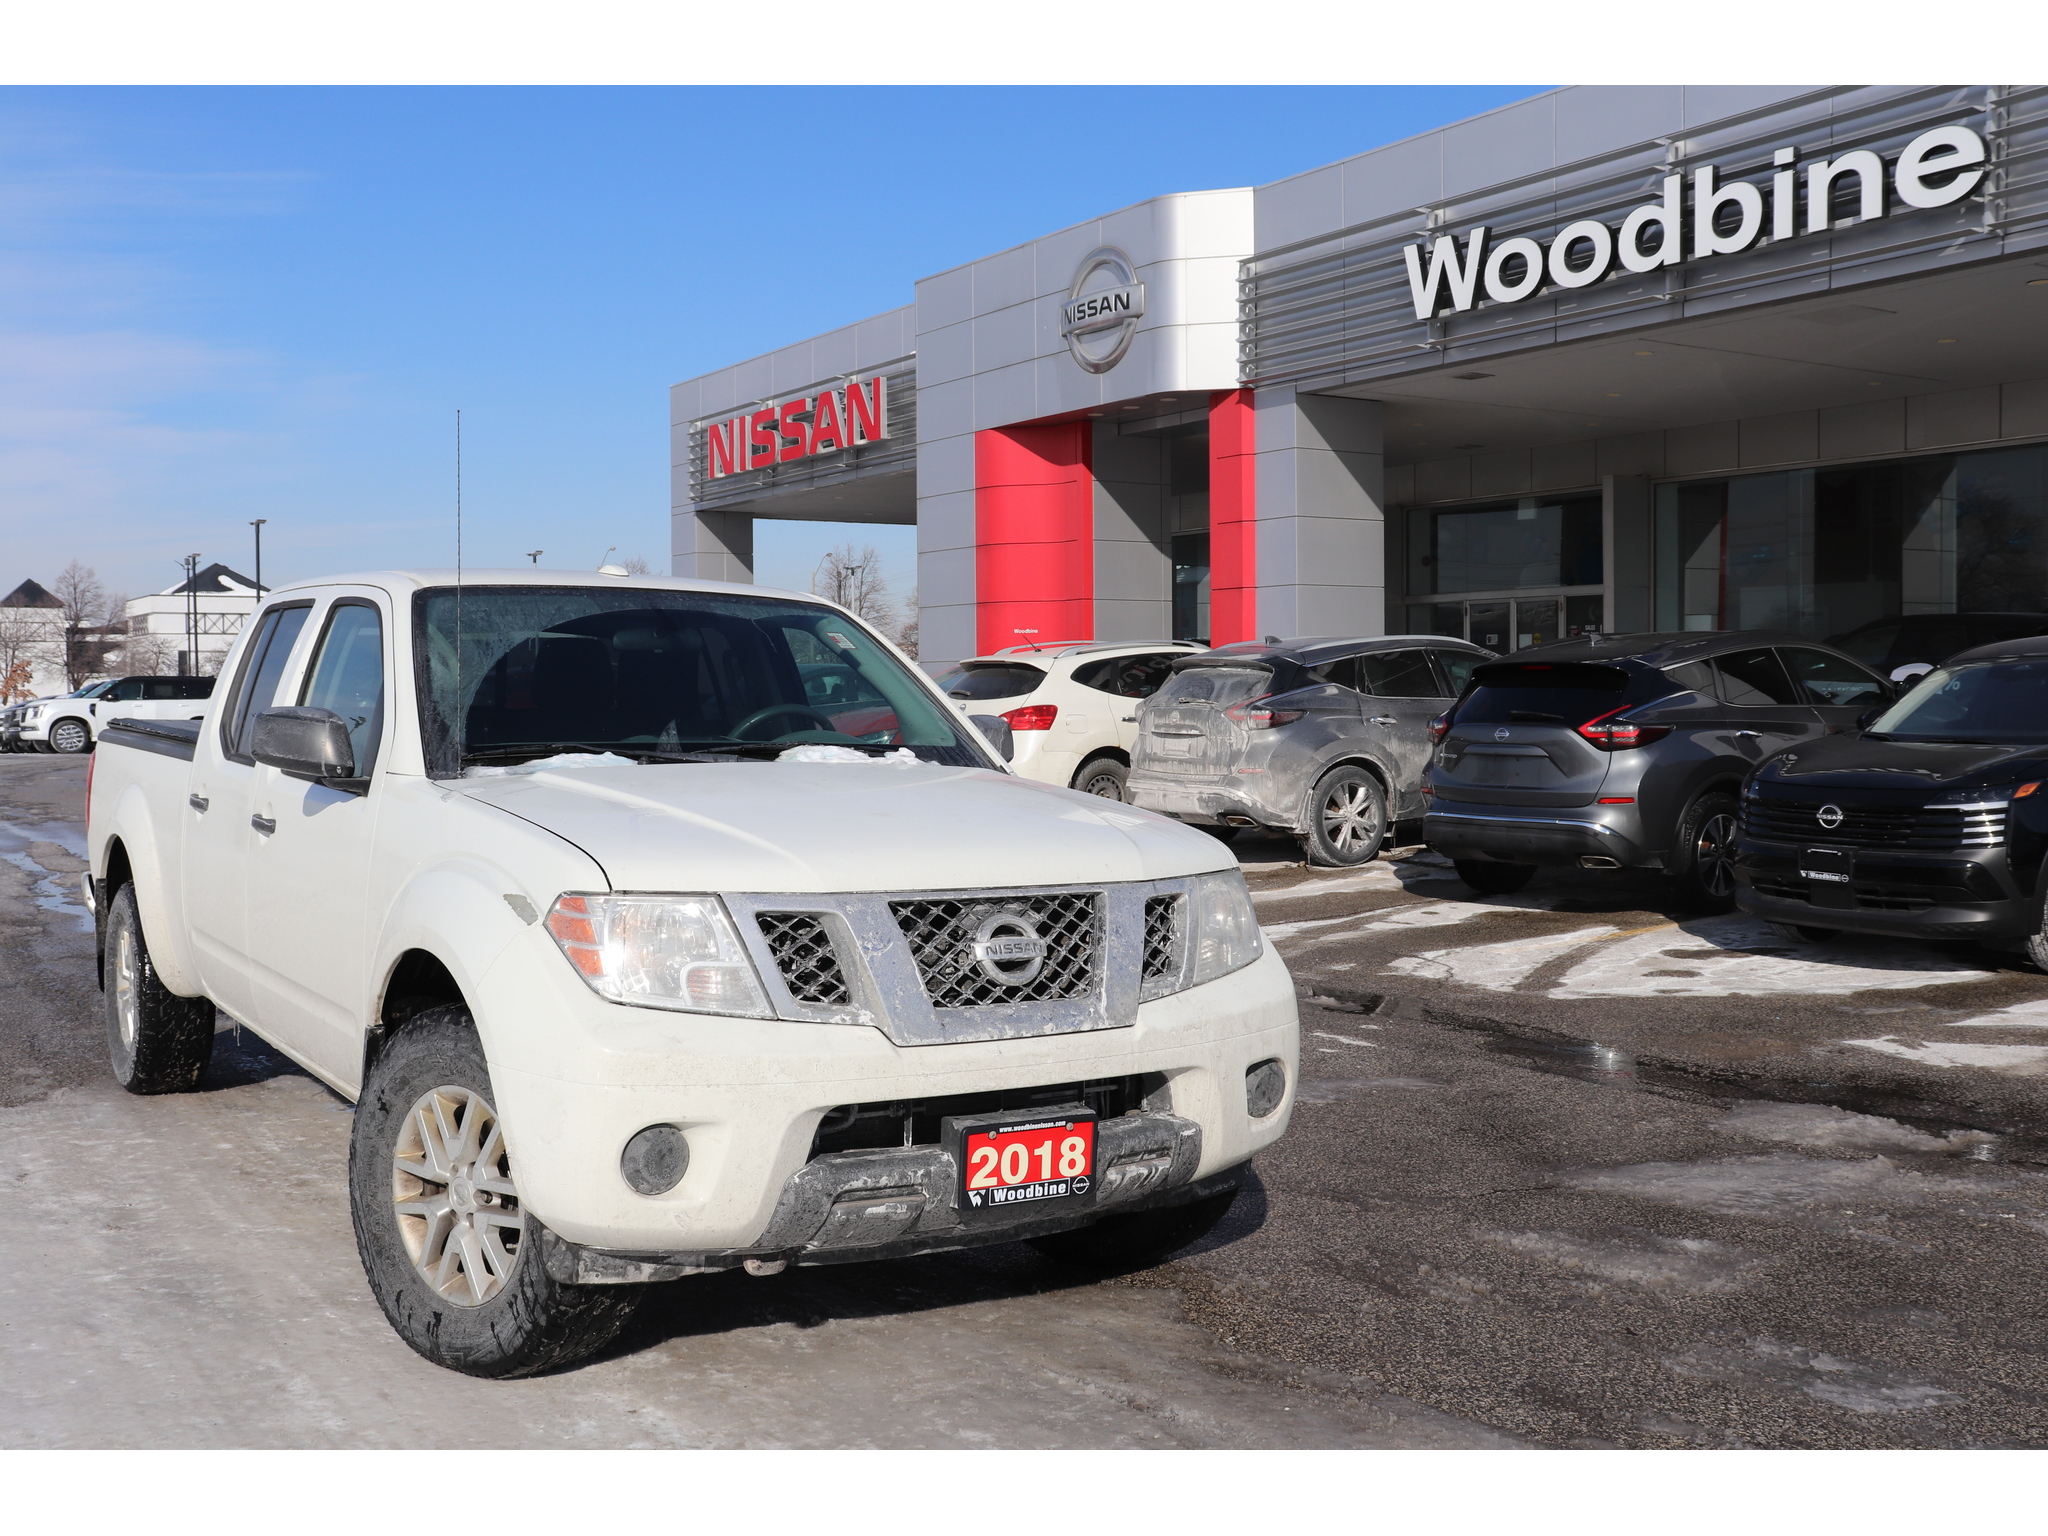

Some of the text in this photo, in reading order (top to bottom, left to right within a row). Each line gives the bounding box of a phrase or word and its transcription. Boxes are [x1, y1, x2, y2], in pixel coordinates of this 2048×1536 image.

[1403, 124, 1987, 320] Woodbine
[1064, 292, 1130, 326] NISSAN
[708, 376, 887, 479] NISSAN
[986, 942, 1043, 956] NISSAN
[969, 1136, 1086, 1189] 2018
[993, 1182, 1067, 1203] Woodbine
